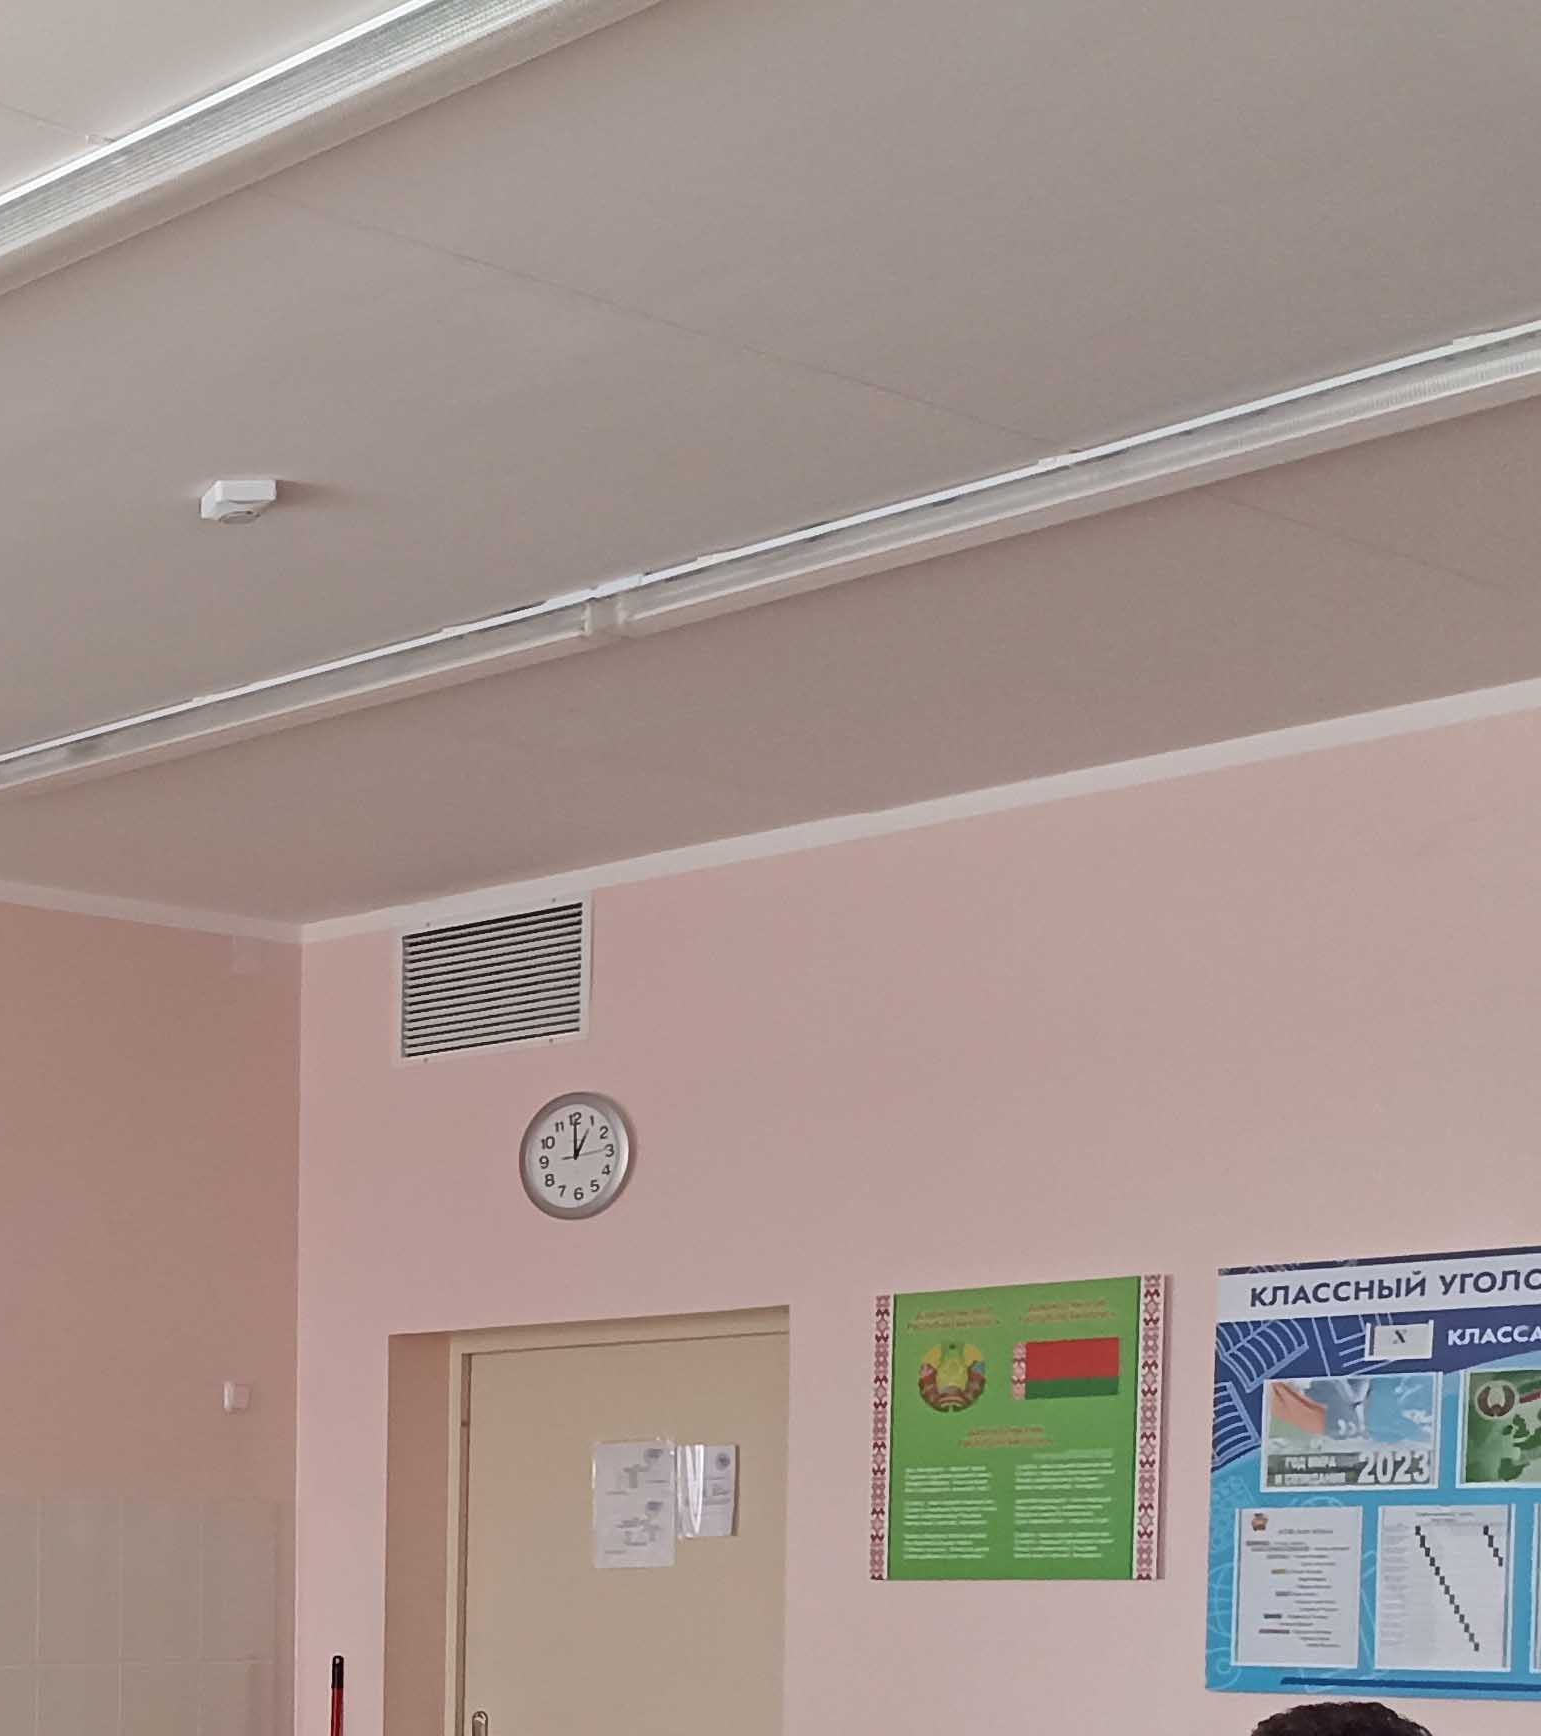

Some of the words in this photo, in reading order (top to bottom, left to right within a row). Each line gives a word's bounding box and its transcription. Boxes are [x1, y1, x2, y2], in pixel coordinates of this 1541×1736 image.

[568, 1111, 582, 1126] 12
[589, 1115, 595, 1126] 1
[554, 1121, 565, 1133] 11
[599, 1125, 609, 1139] 2
[541, 1136, 556, 1150] 10
[605, 1143, 615, 1158] 3
[539, 1155, 549, 1169] 9
[601, 1164, 611, 1175] 4
[544, 1173, 555, 1187] 8
[590, 1179, 600, 1192] 5
[558, 1185, 566, 1198] 7
[573, 1187, 584, 1200] 6
[1249, 1270, 1427, 1307] КЛАССНЫЙ
[1447, 1325, 1541, 1347] КЛАССА
[1357, 1450, 1430, 1484] 2023
